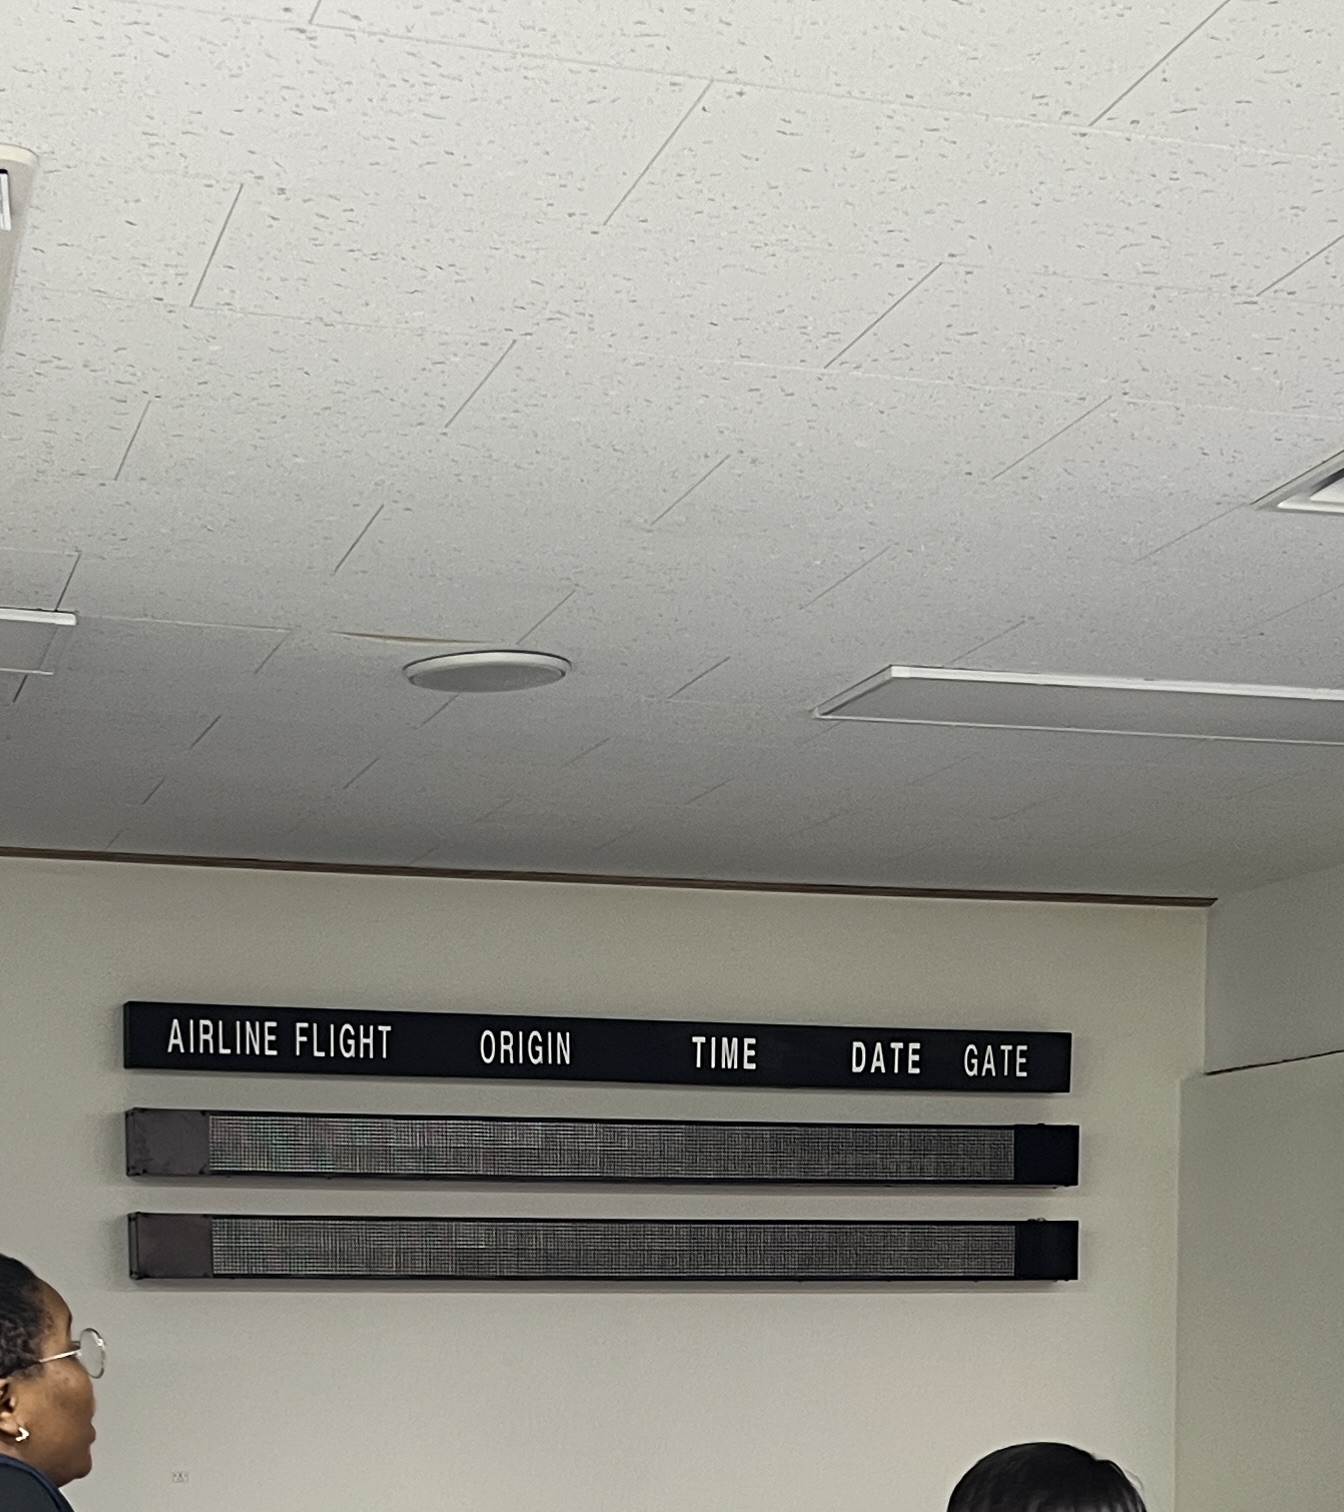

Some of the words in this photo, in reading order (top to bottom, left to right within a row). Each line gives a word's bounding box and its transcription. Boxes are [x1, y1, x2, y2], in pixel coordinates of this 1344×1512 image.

[167, 1018, 279, 1057] AIRLINE
[295, 1022, 394, 1060] FLIGHT
[479, 1029, 572, 1066] ORIGIN
[691, 1035, 758, 1070] TIME
[851, 1042, 922, 1075] DATE
[963, 1044, 1029, 1077] GATE
